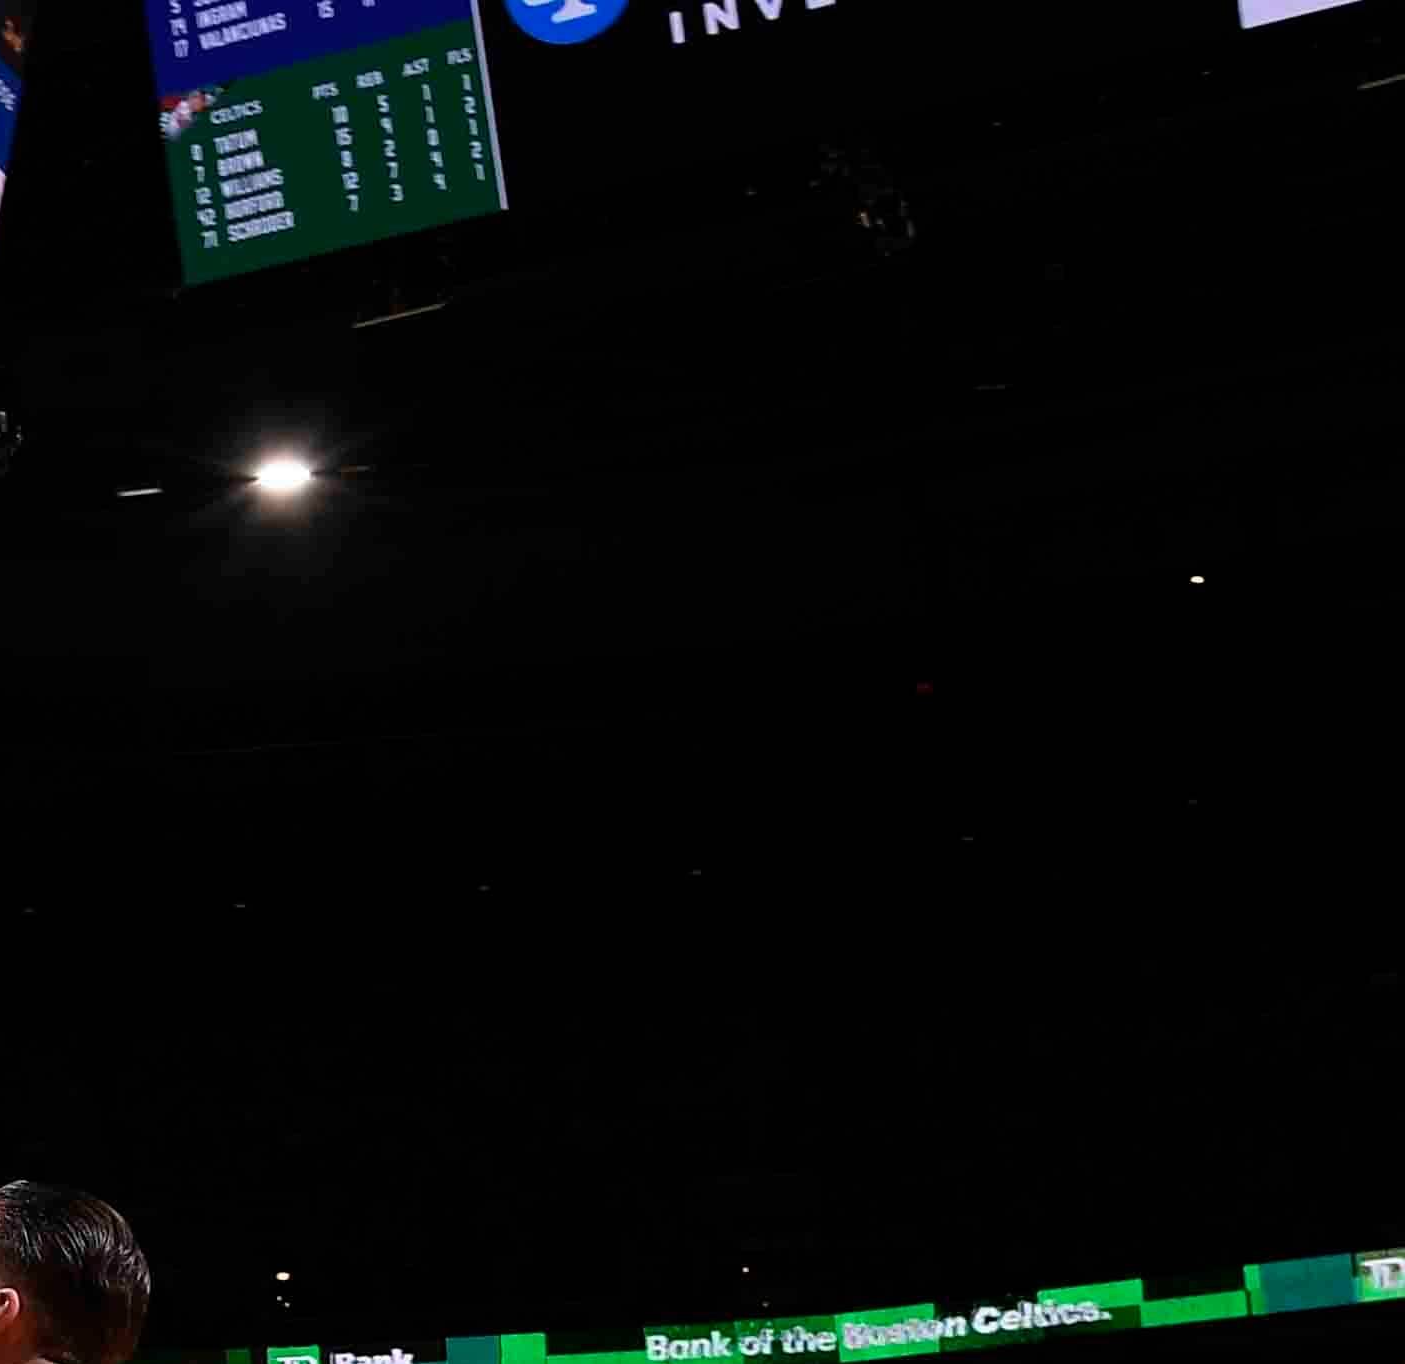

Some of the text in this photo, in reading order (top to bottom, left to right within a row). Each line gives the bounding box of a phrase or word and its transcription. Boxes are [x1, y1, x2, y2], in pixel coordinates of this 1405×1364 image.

[198, 12, 287, 50] VALANCIUNAS
[210, 101, 263, 124] CELTICS
[217, 150, 264, 177] BROWN
[464, 95, 477, 113] 2
[213, 129, 258, 154] TATUM
[220, 168, 284, 198] WILLIAMS
[383, 139, 396, 157] 2
[223, 191, 285, 220] HORFORD
[469, 141, 483, 159] 2
[389, 184, 403, 201] 3
[645, 1299, 1112, 1361] Bank of the Boston Celtics.
